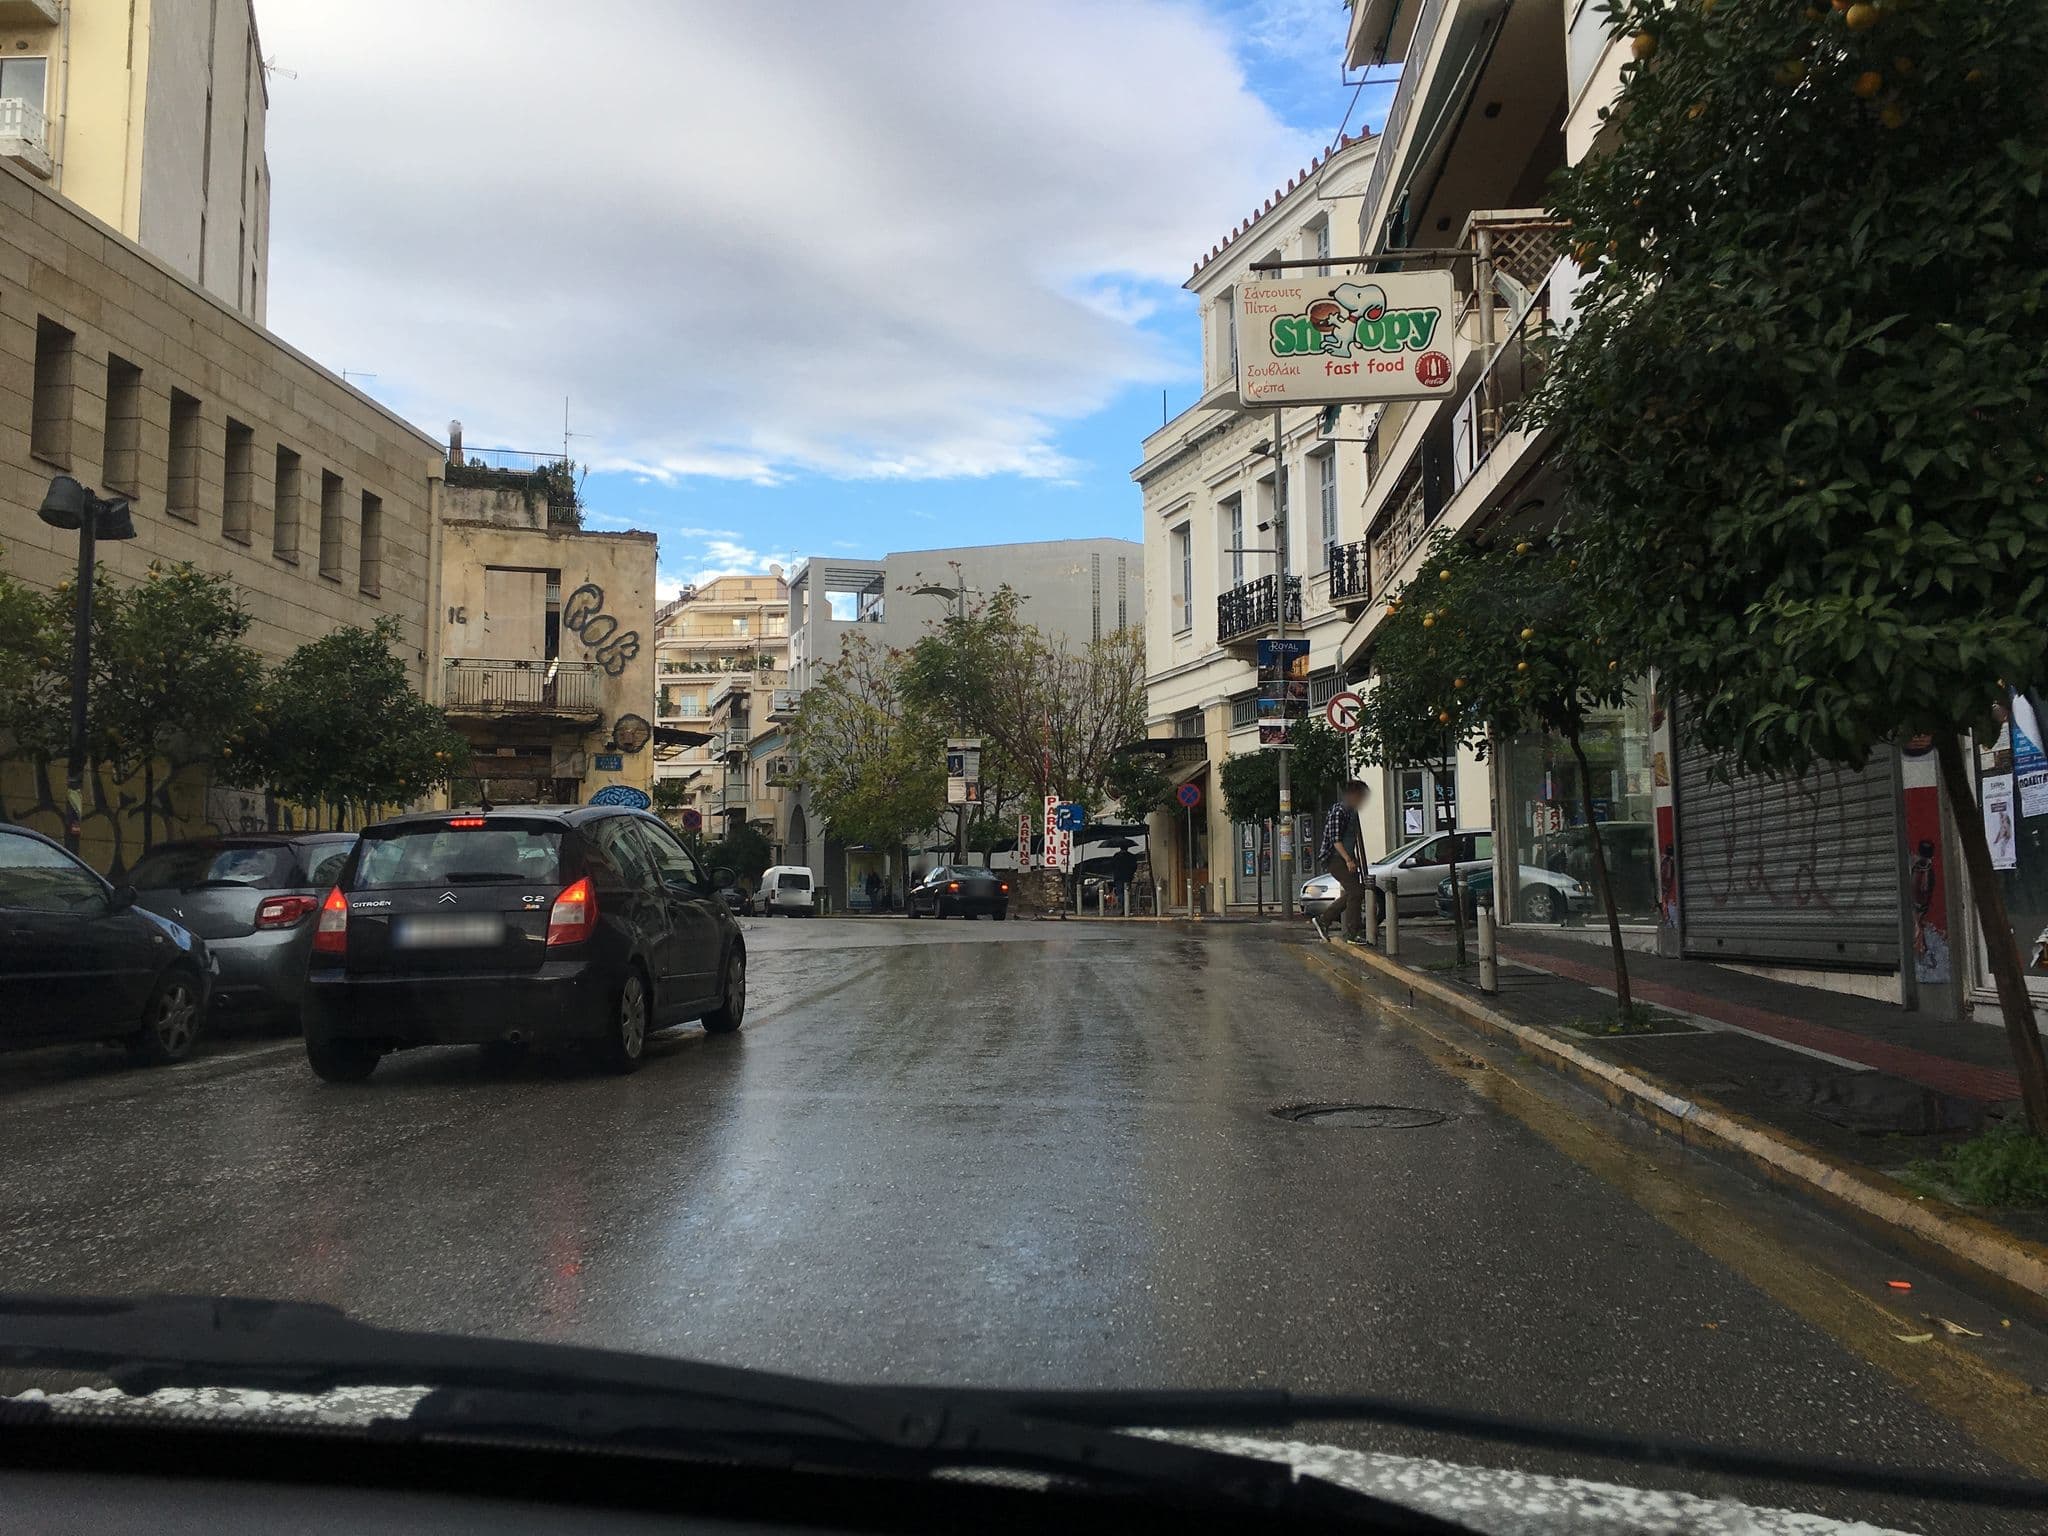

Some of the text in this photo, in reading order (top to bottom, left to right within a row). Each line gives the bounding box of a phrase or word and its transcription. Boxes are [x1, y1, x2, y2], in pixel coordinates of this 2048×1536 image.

[1244, 287, 1302, 300] Σάντουιτς
[1244, 301, 1277, 315] Πίττα
[1272, 308, 1440, 355] snopy
[1247, 361, 1301, 378] Σουβλάκι
[1324, 359, 1360, 377] fast
[1367, 358, 1405, 374] food
[1247, 380, 1286, 398] Κρέπα
[1268, 641, 1299, 652] ROYAL
[1060, 808, 1071, 827] P
[1046, 797, 1057, 865] PARKING
[1020, 815, 1030, 866] PARKING
